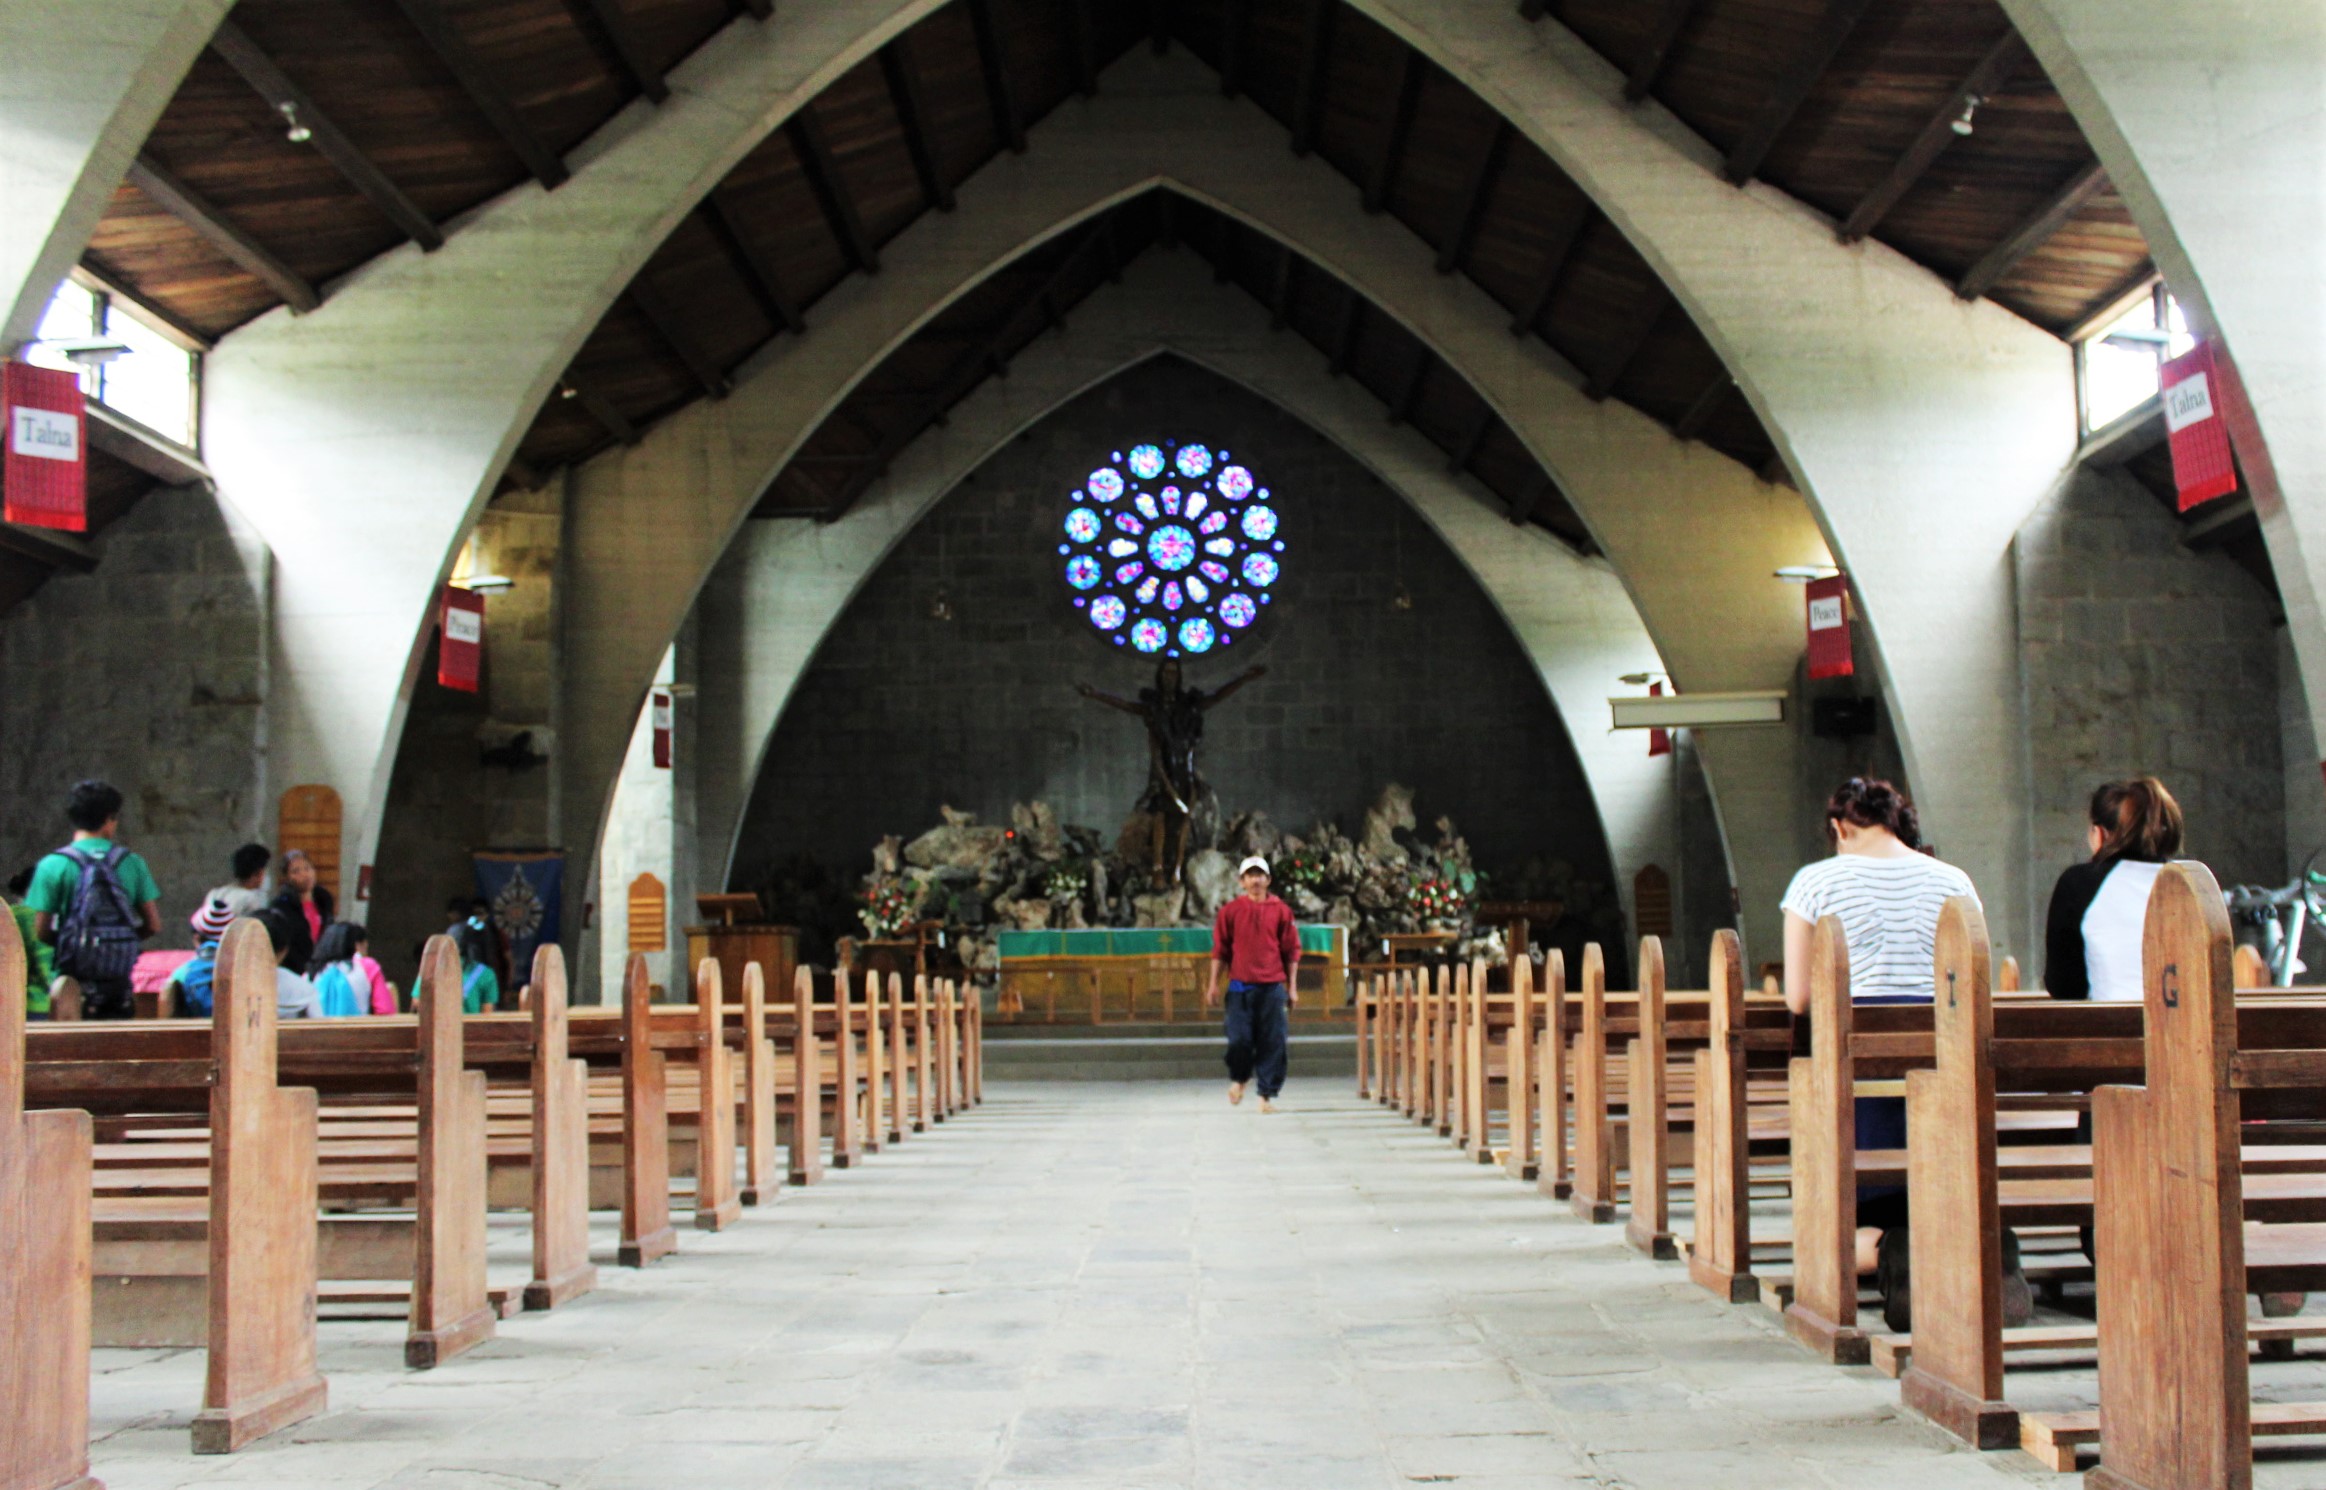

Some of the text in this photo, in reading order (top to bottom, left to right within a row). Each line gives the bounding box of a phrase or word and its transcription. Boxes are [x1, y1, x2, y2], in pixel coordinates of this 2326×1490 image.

[2168, 388, 2207, 419] Talna
[21, 416, 71, 448] Talna
[2162, 964, 2178, 1008] G
